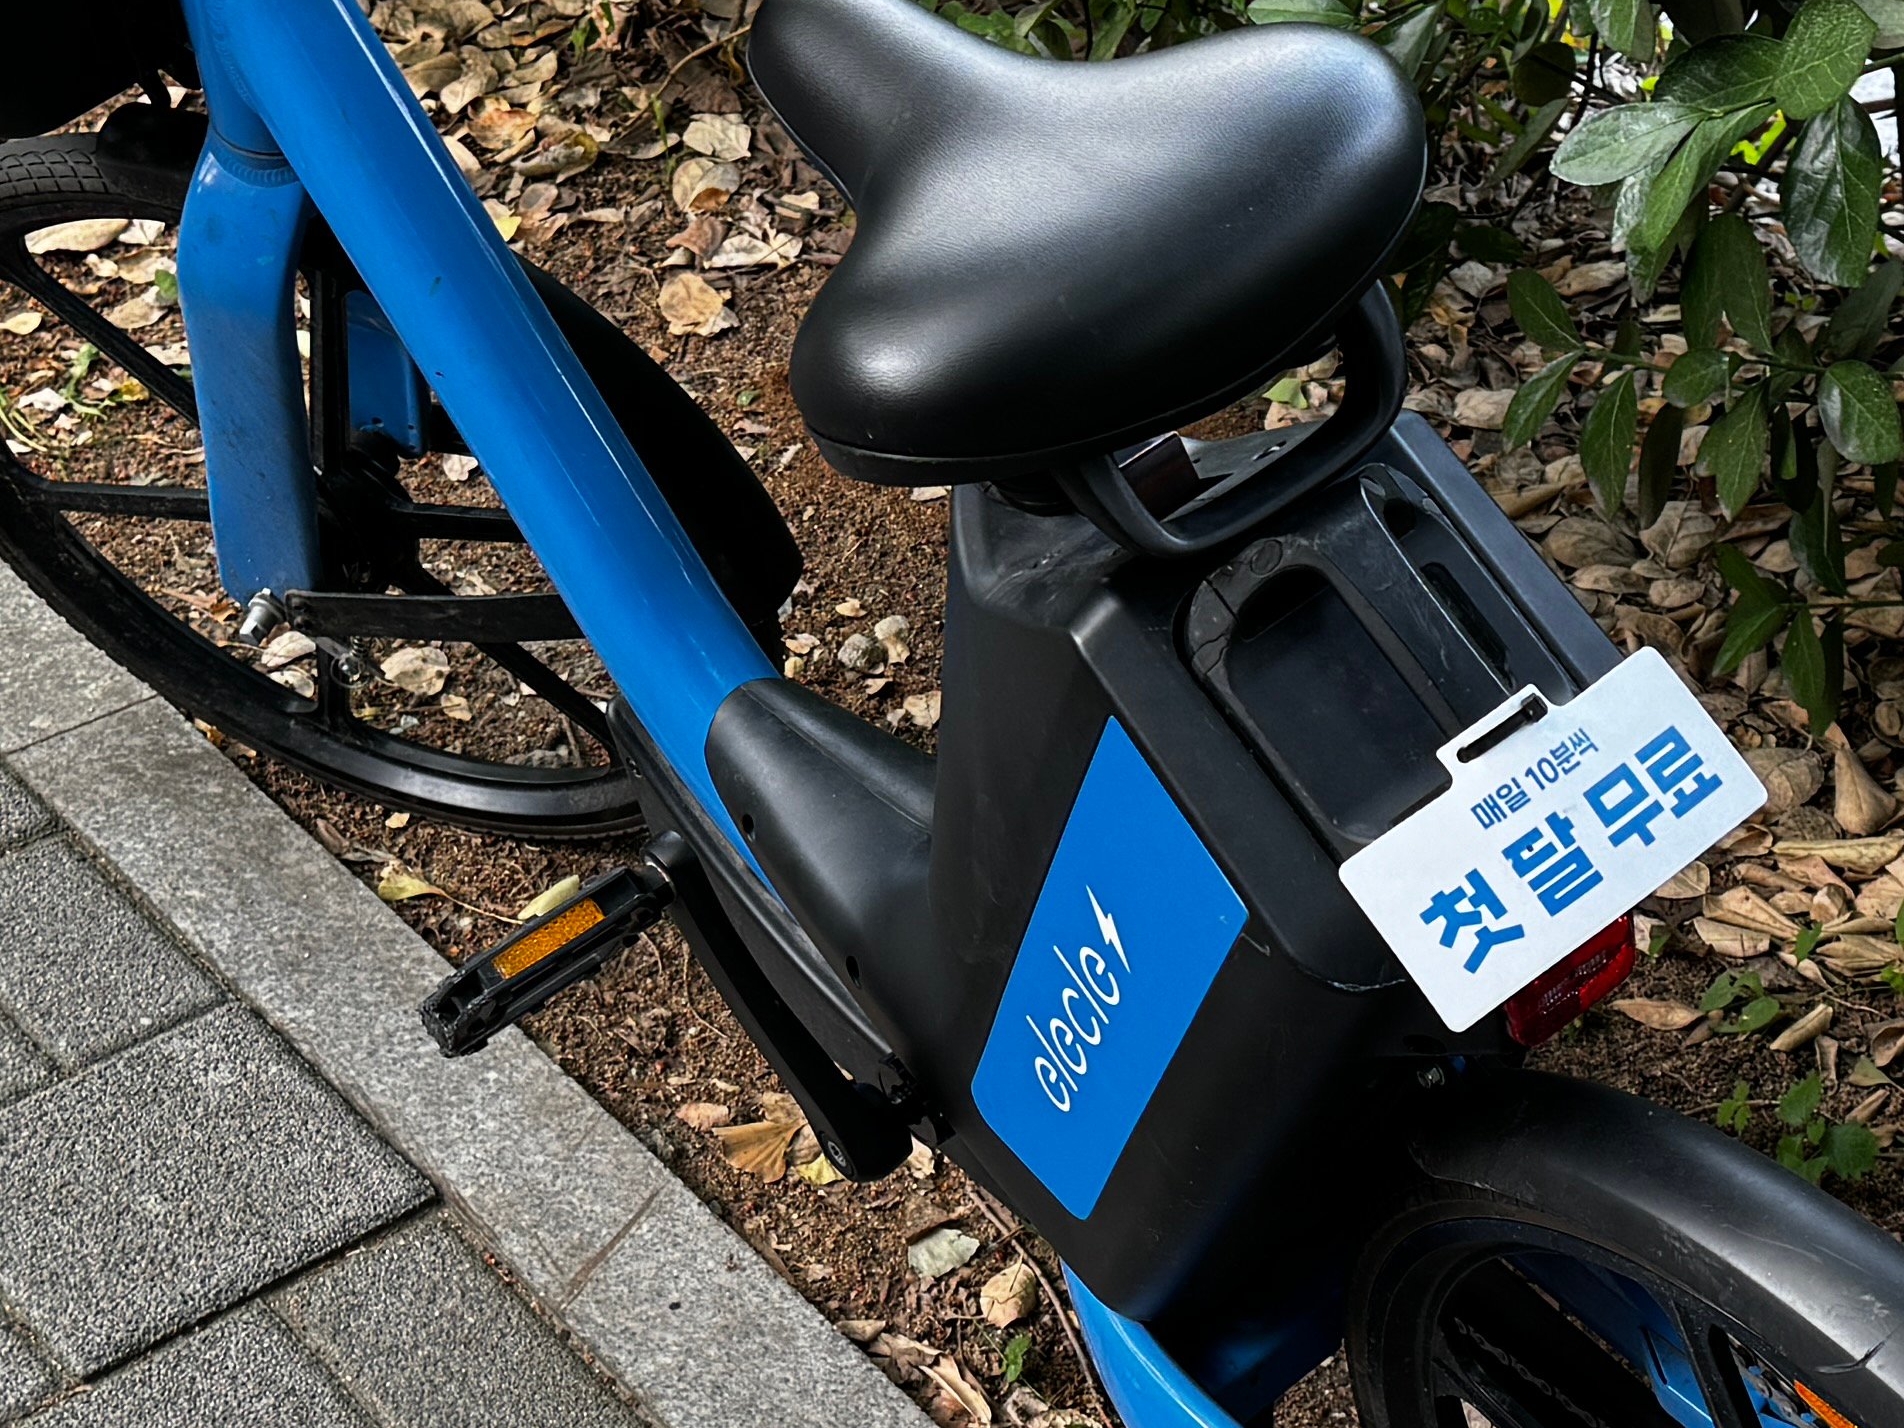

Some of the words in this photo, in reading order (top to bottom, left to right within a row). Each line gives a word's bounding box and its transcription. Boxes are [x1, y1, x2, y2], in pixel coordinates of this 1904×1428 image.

[1470, 777, 1532, 830] 매일
[1524, 727, 1600, 792] 10분씩
[1583, 725, 1723, 847] 무료
[1026, 945, 1121, 1112] elecle
